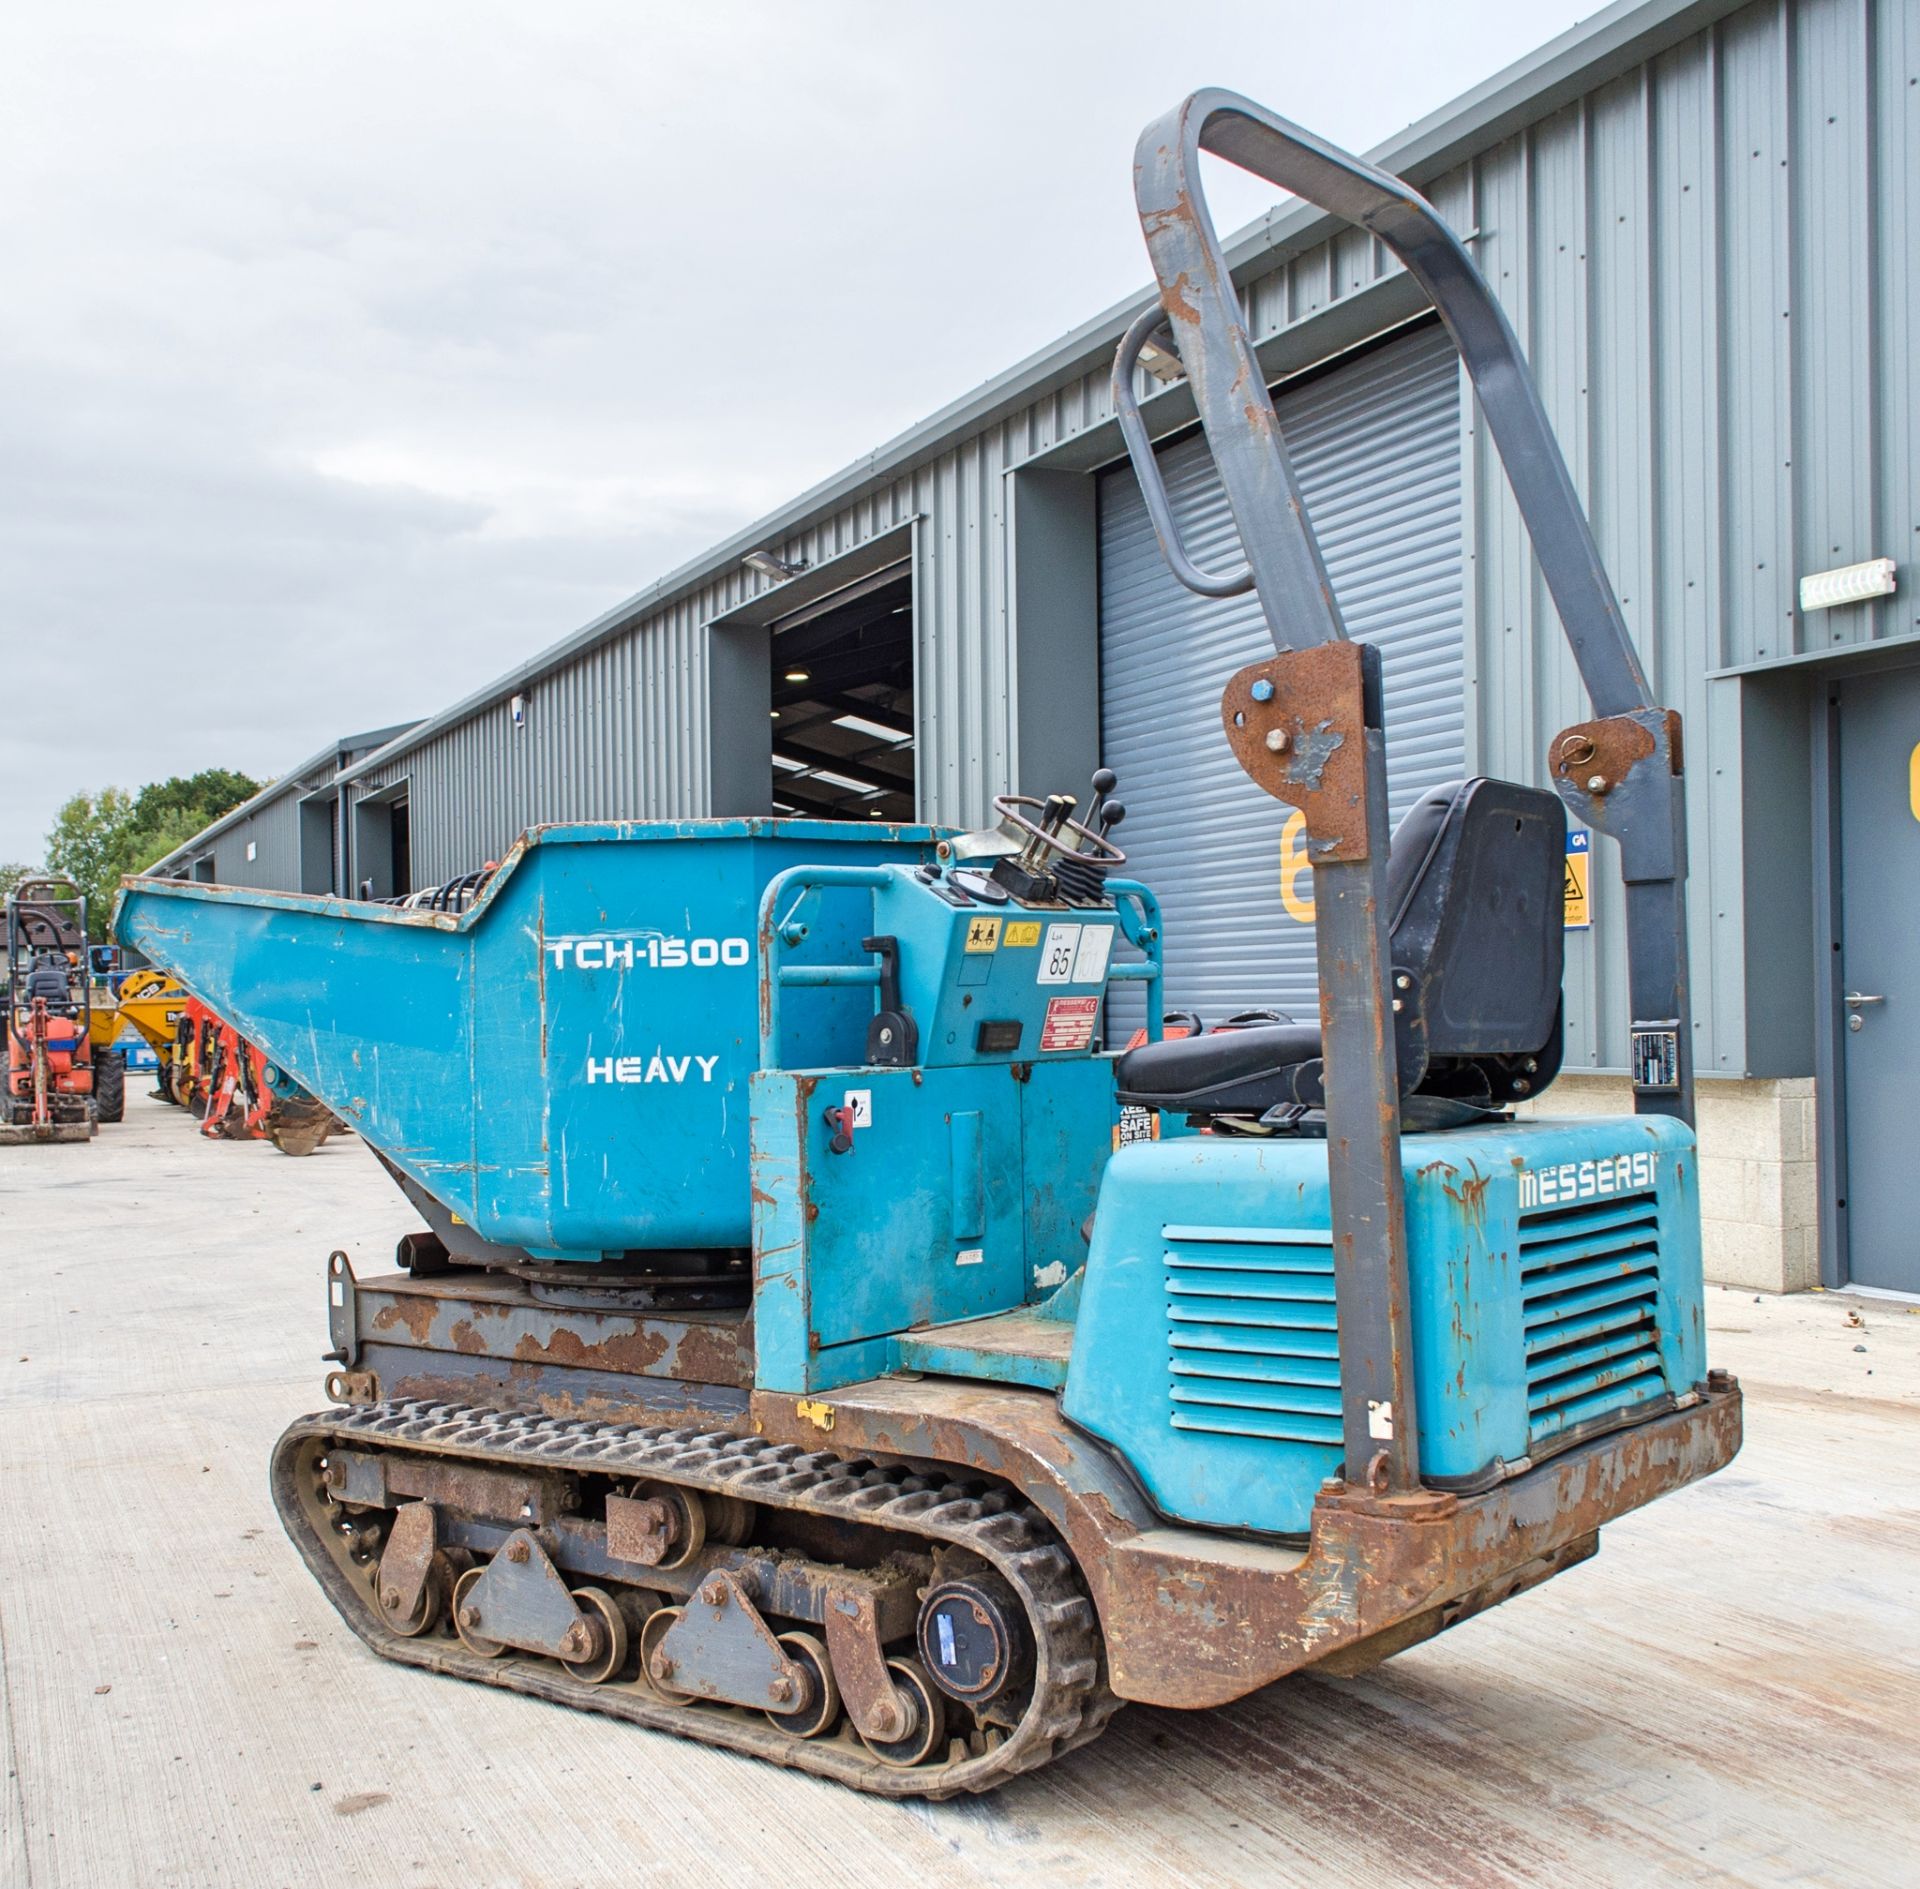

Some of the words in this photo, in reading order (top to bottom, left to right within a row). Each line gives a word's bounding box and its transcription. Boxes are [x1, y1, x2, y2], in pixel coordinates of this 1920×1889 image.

[546, 937, 750, 970] TCH-1500
[1049, 947, 1071, 976] 85
[587, 1055, 720, 1084] HEAVY
[1120, 1117, 1151, 1133] SAFE
[1120, 1132, 1133, 1141] ON
[1134, 1130, 1151, 1139] SITE
[1518, 1151, 1660, 1209] MESSERSI
